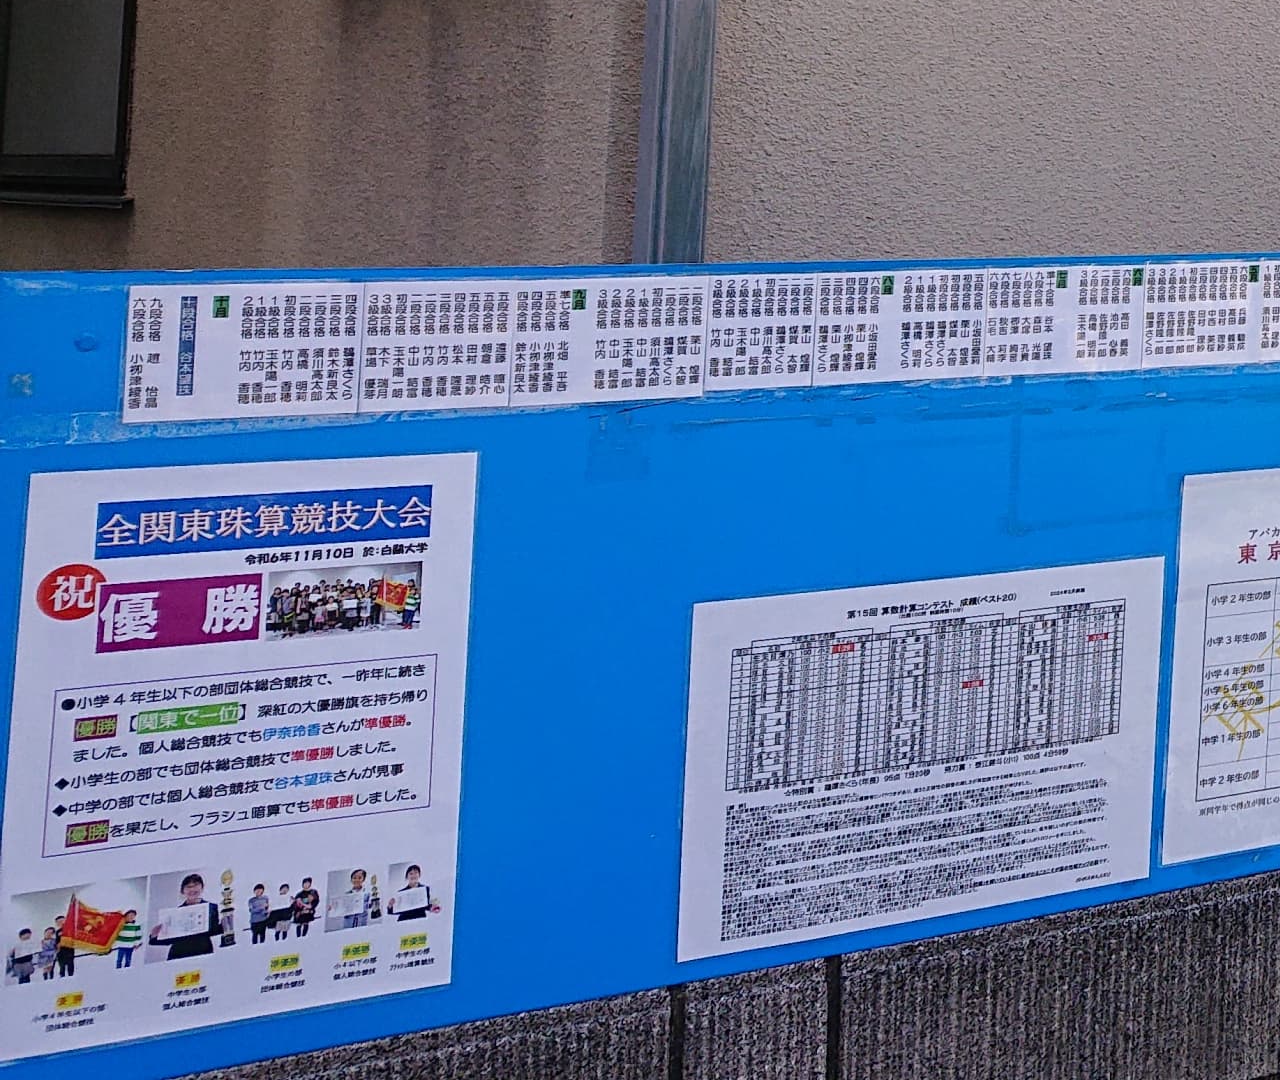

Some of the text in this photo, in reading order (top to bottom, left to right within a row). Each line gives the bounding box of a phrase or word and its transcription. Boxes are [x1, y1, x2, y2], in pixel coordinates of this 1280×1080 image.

[131, 298, 147, 342] 六段合格
[148, 298, 163, 342] 九段合格
[283, 295, 297, 338] 初段合格
[298, 295, 312, 337] 二段合格
[313, 295, 327, 337] 二段合格
[328, 295, 342, 337] 三段合格
[344, 294, 358, 337] 四段合格
[98, 497, 432, 547] 全関東珠算競技大会
[244, 547, 355, 566] 令和6年11月10日
[48, 574, 94, 612] 祝
[1211, 591, 1271, 606] 小学2年生の部
[1207, 632, 1267, 647] 小学3年生の部
[1200, 770, 1259, 787] 中学2年生の部
